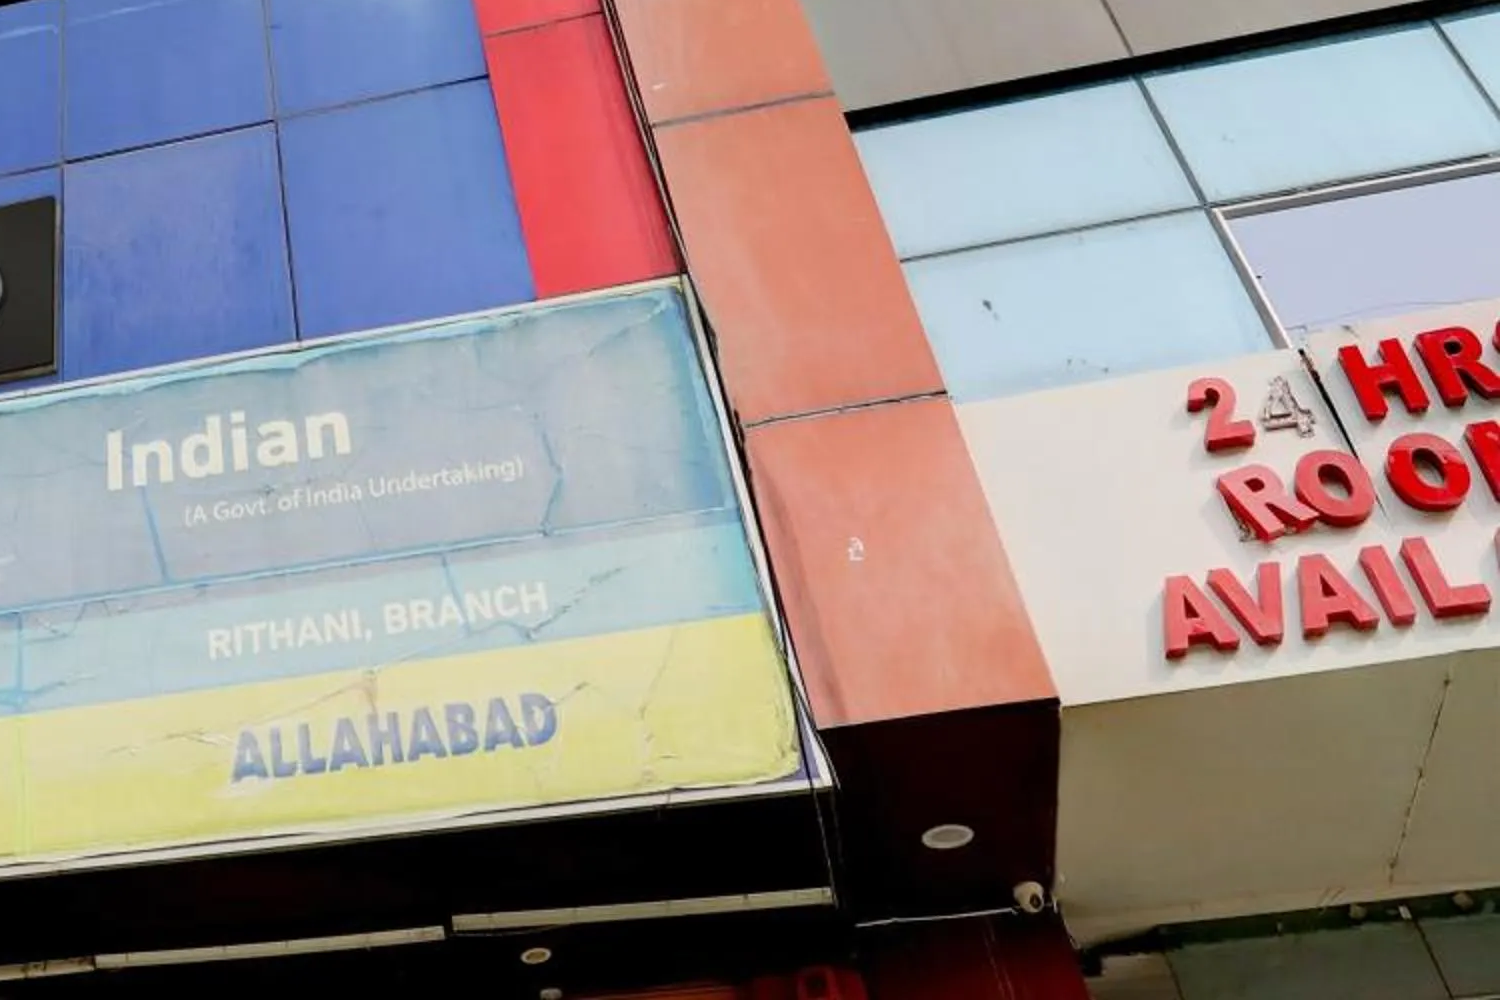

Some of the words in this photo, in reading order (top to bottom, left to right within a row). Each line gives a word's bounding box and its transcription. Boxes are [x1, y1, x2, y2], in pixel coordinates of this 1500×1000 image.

[1338, 325, 1500, 422] HR
[106, 410, 352, 491] Indian
[304, 479, 362, 507] India
[368, 456, 524, 498] Undertaking)
[207, 605, 372, 660] RITHANI,
[384, 581, 550, 634] BRANCH
[1162, 526, 1500, 660] AVAIL
[230, 692, 559, 784] ALLAHABAD
